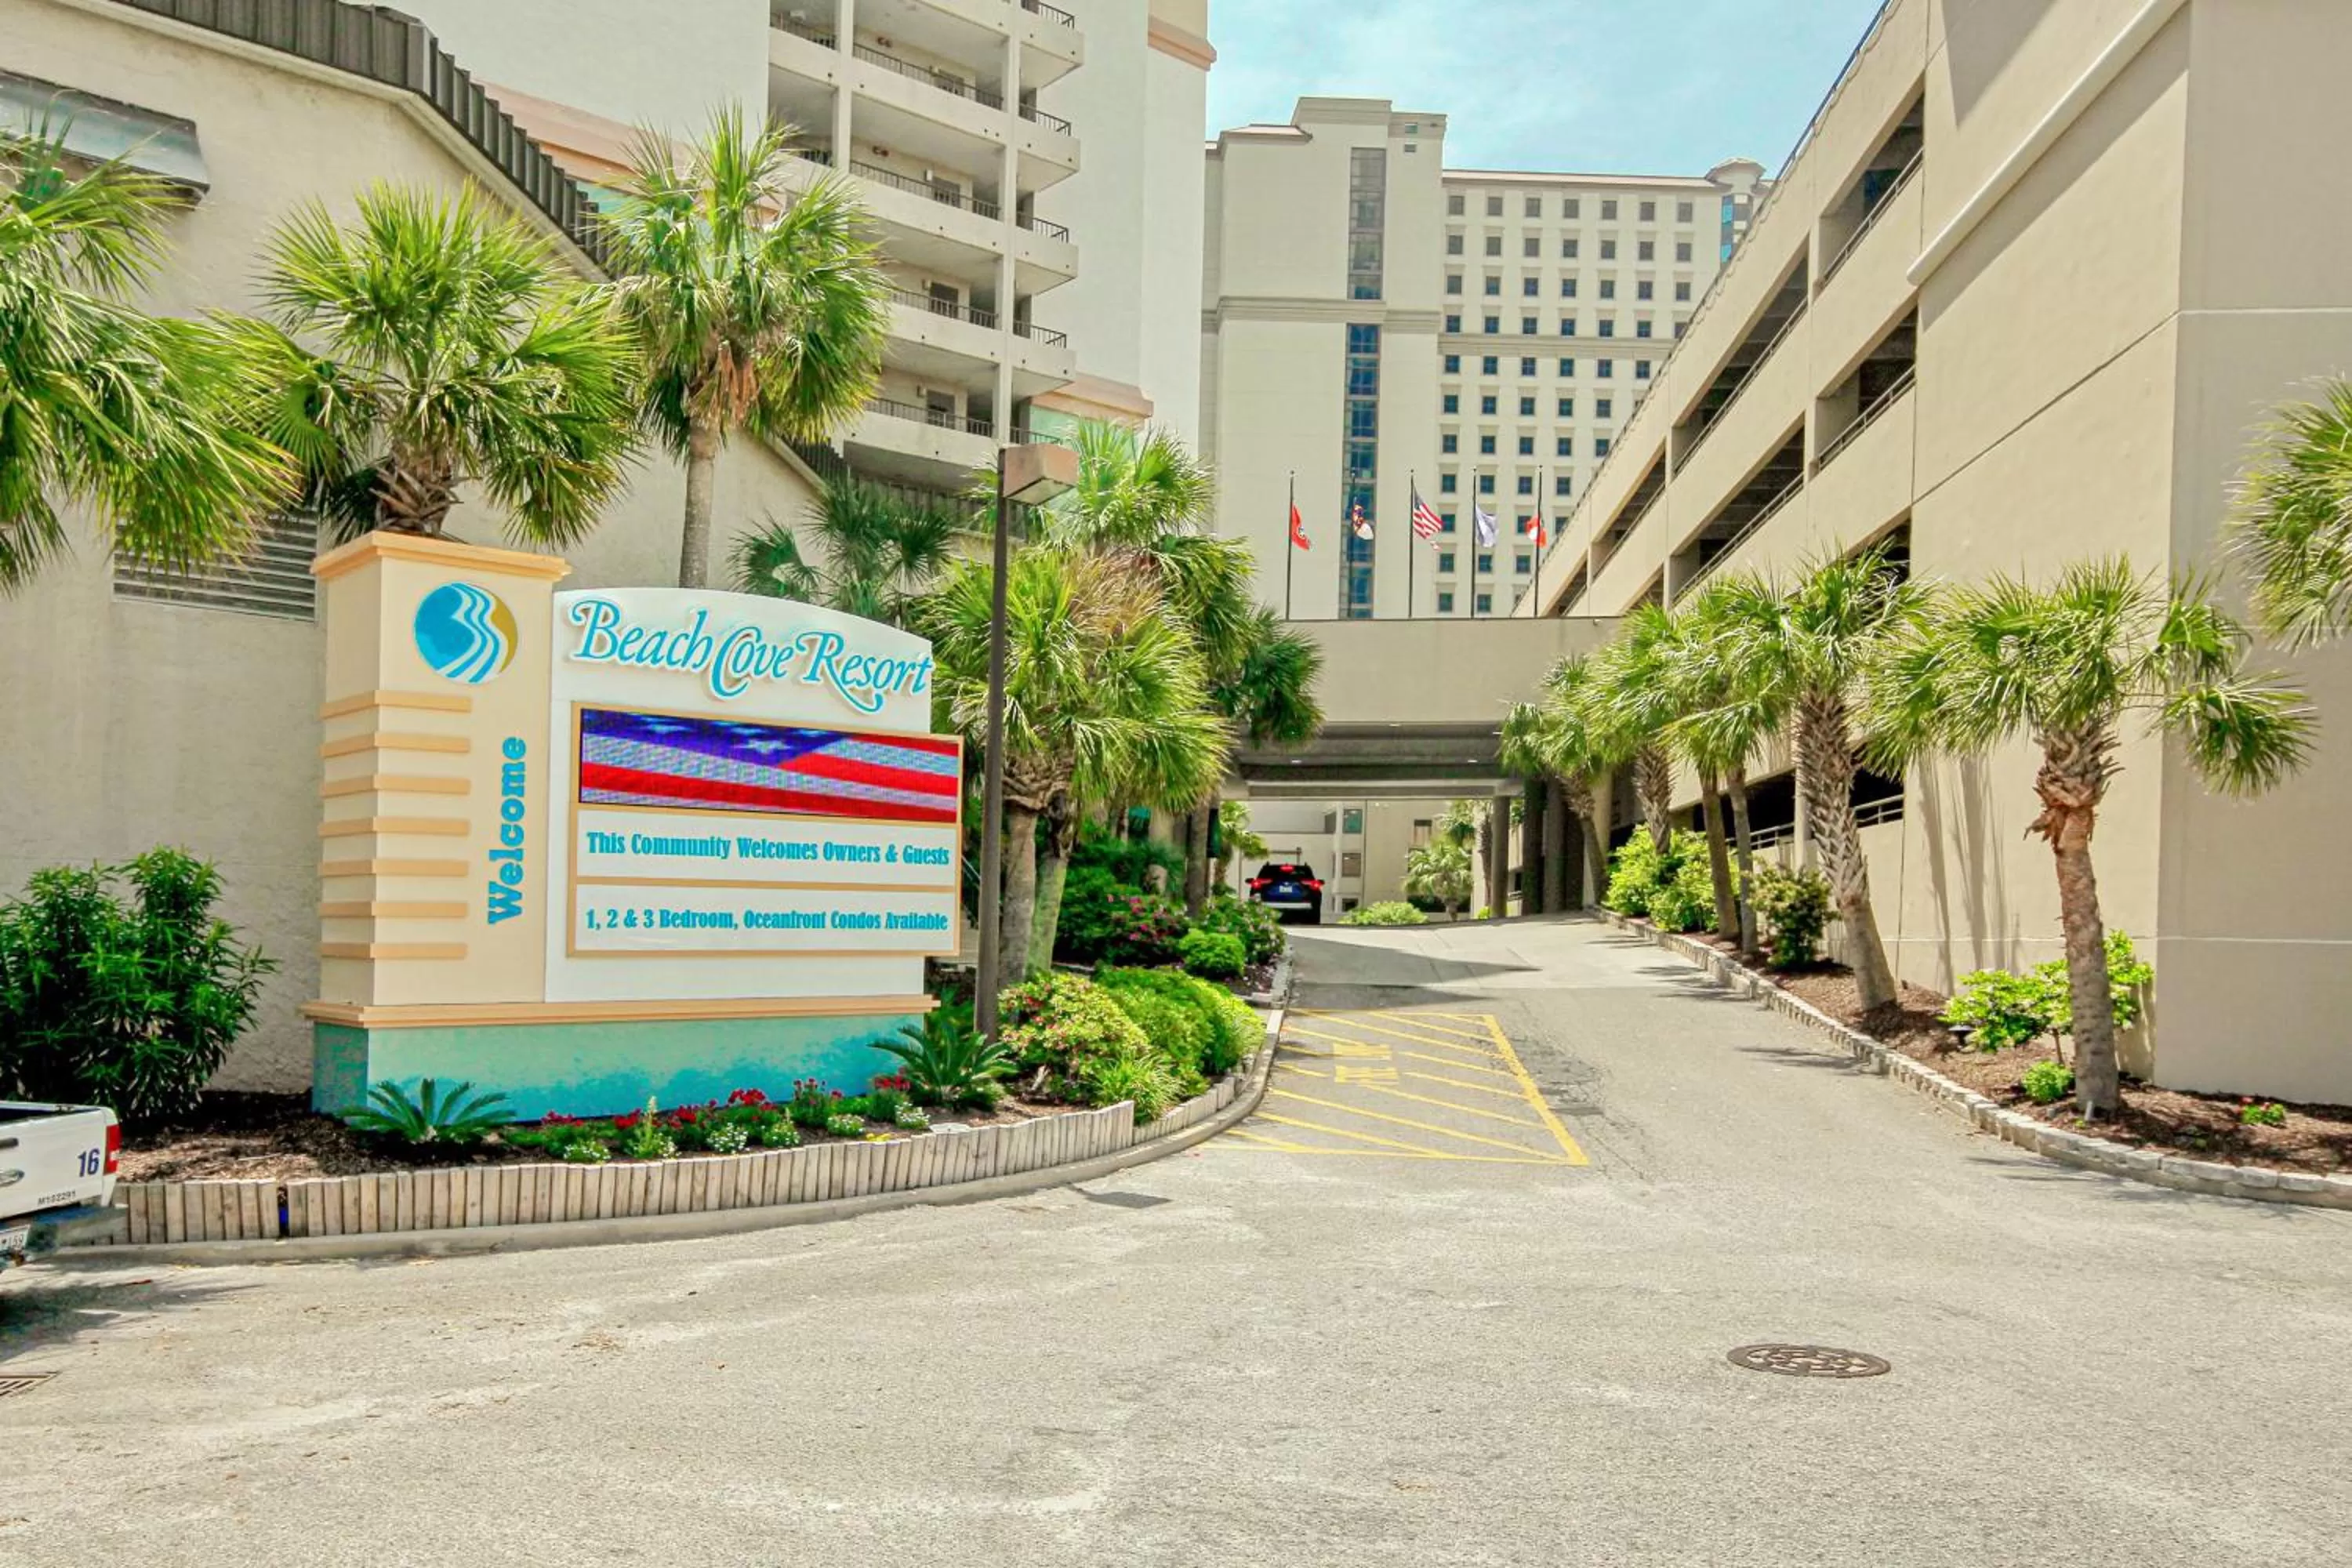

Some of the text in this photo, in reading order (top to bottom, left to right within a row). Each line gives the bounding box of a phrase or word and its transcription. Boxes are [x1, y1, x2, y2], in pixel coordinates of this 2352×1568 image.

[571, 599, 935, 713] Beach Cove Resort
[487, 736, 526, 925] Welcome
[587, 832, 949, 865] This Community Welcomes Owners & Guests
[586, 909, 948, 931] 1, 2 & 3 Bedroom, Oceanfront Condos Available
[78, 1149, 100, 1177] 16
